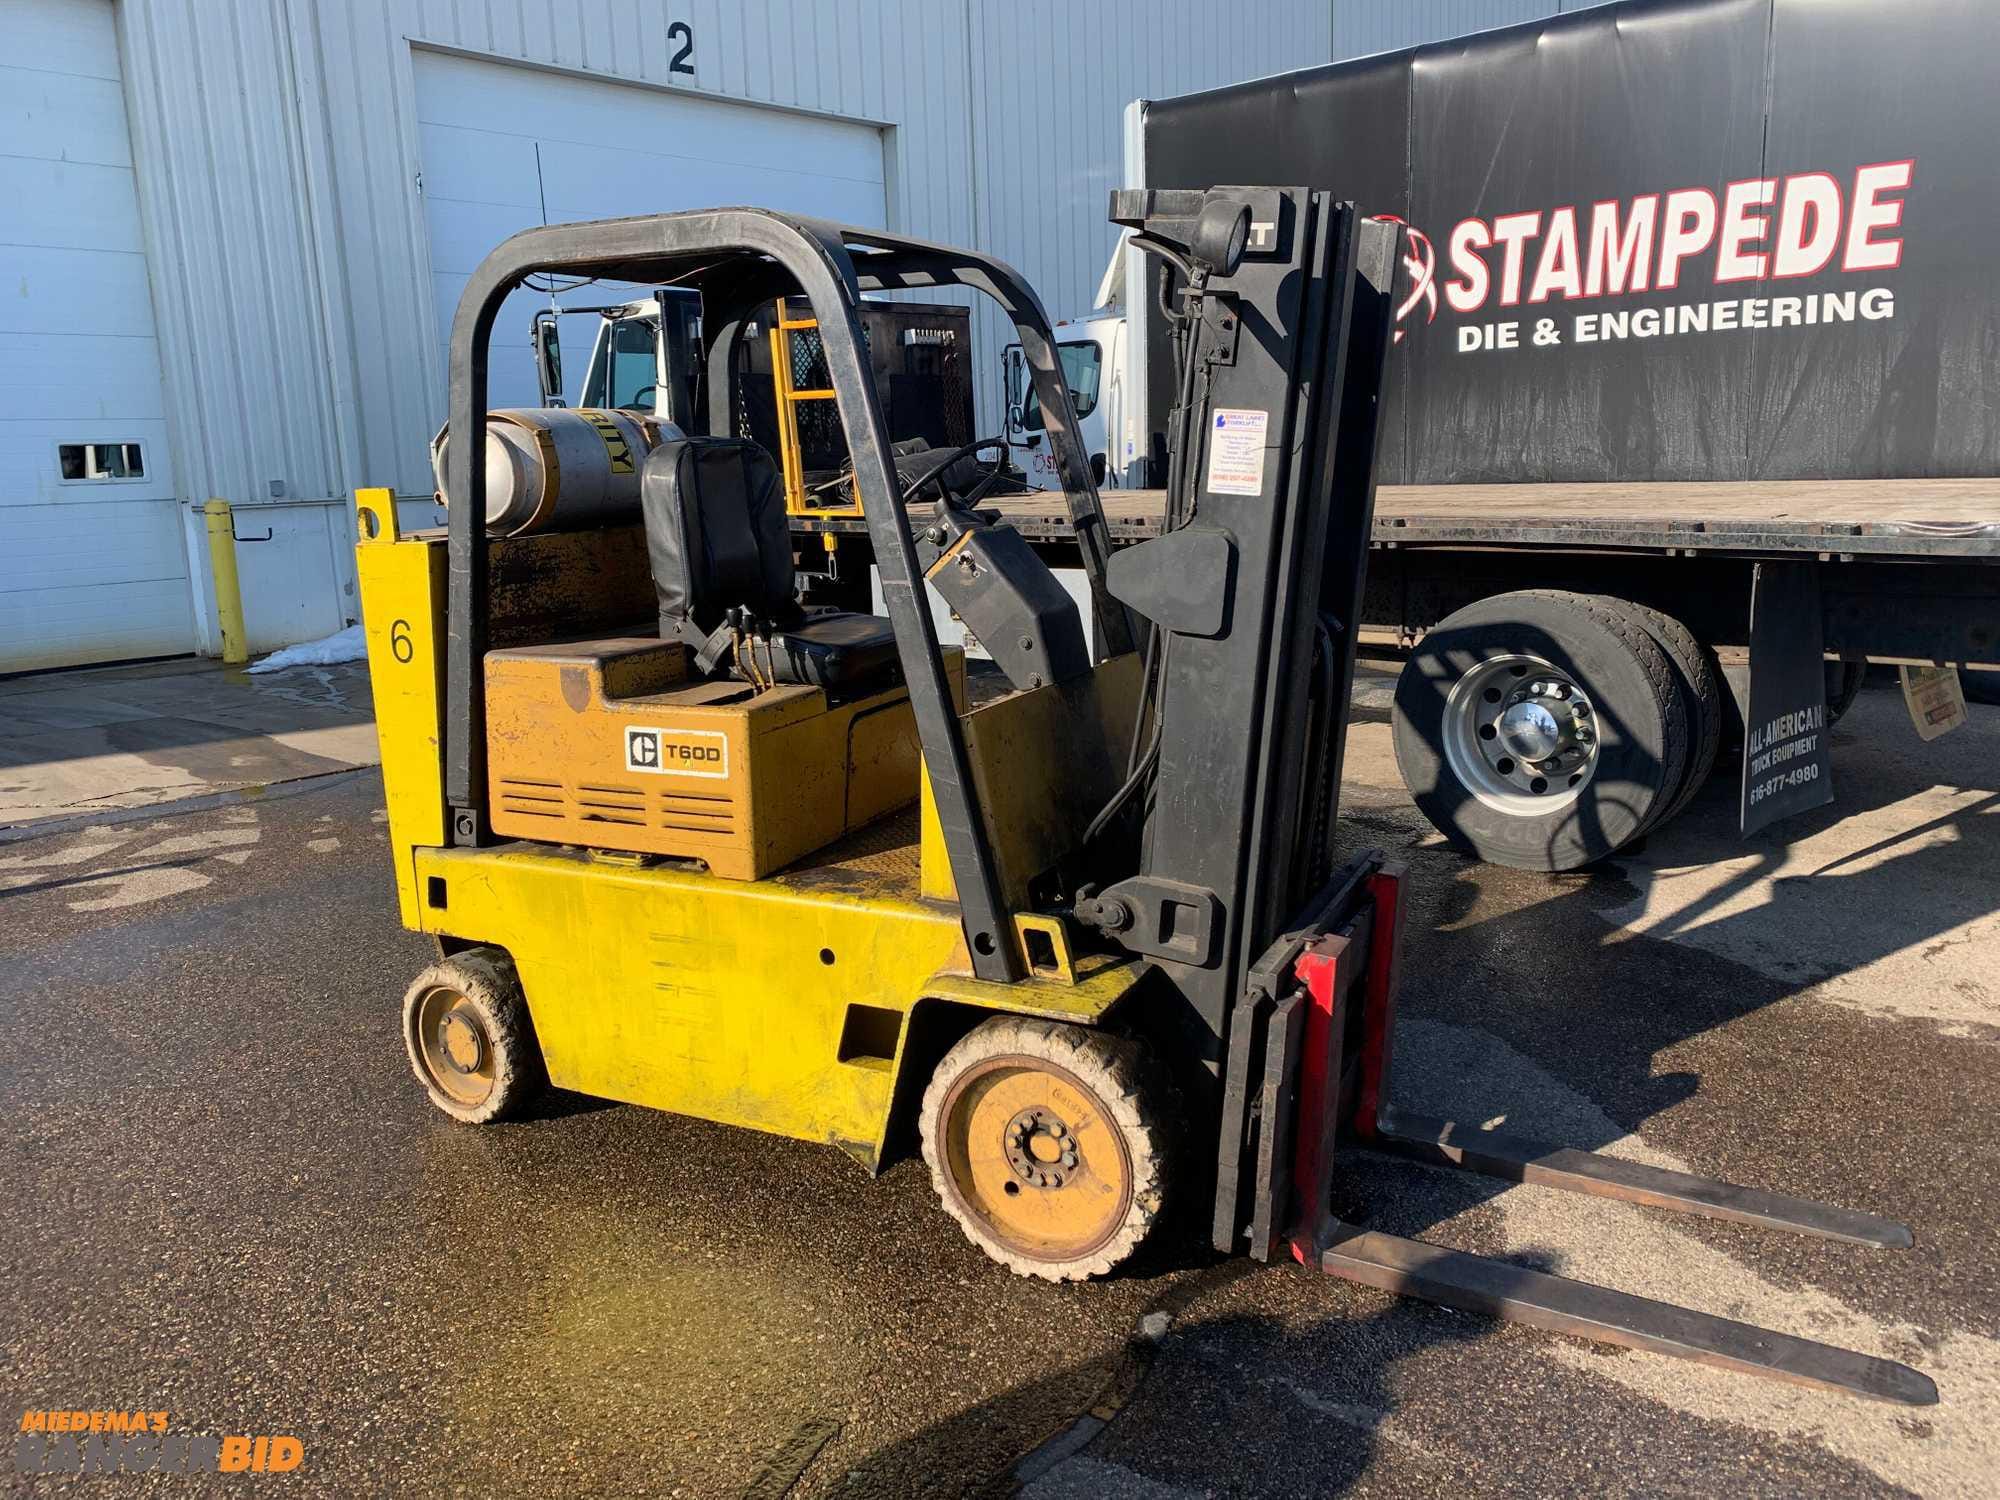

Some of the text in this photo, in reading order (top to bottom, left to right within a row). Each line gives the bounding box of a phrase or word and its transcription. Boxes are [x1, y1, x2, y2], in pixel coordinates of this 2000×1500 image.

[667, 21, 694, 75] 2
[1247, 221, 1275, 246] T
[1445, 159, 1915, 313] STAMPEDE
[1457, 287, 1895, 353] DIE & ENGINEERING
[391, 618, 413, 664] 6
[665, 744, 721, 762] T60D
[1749, 704, 1823, 758] ALL-AMERICAN
[1751, 734, 1818, 777] TRUCK EQUIPMENT
[1750, 762, 1819, 806] 616-877-4980
